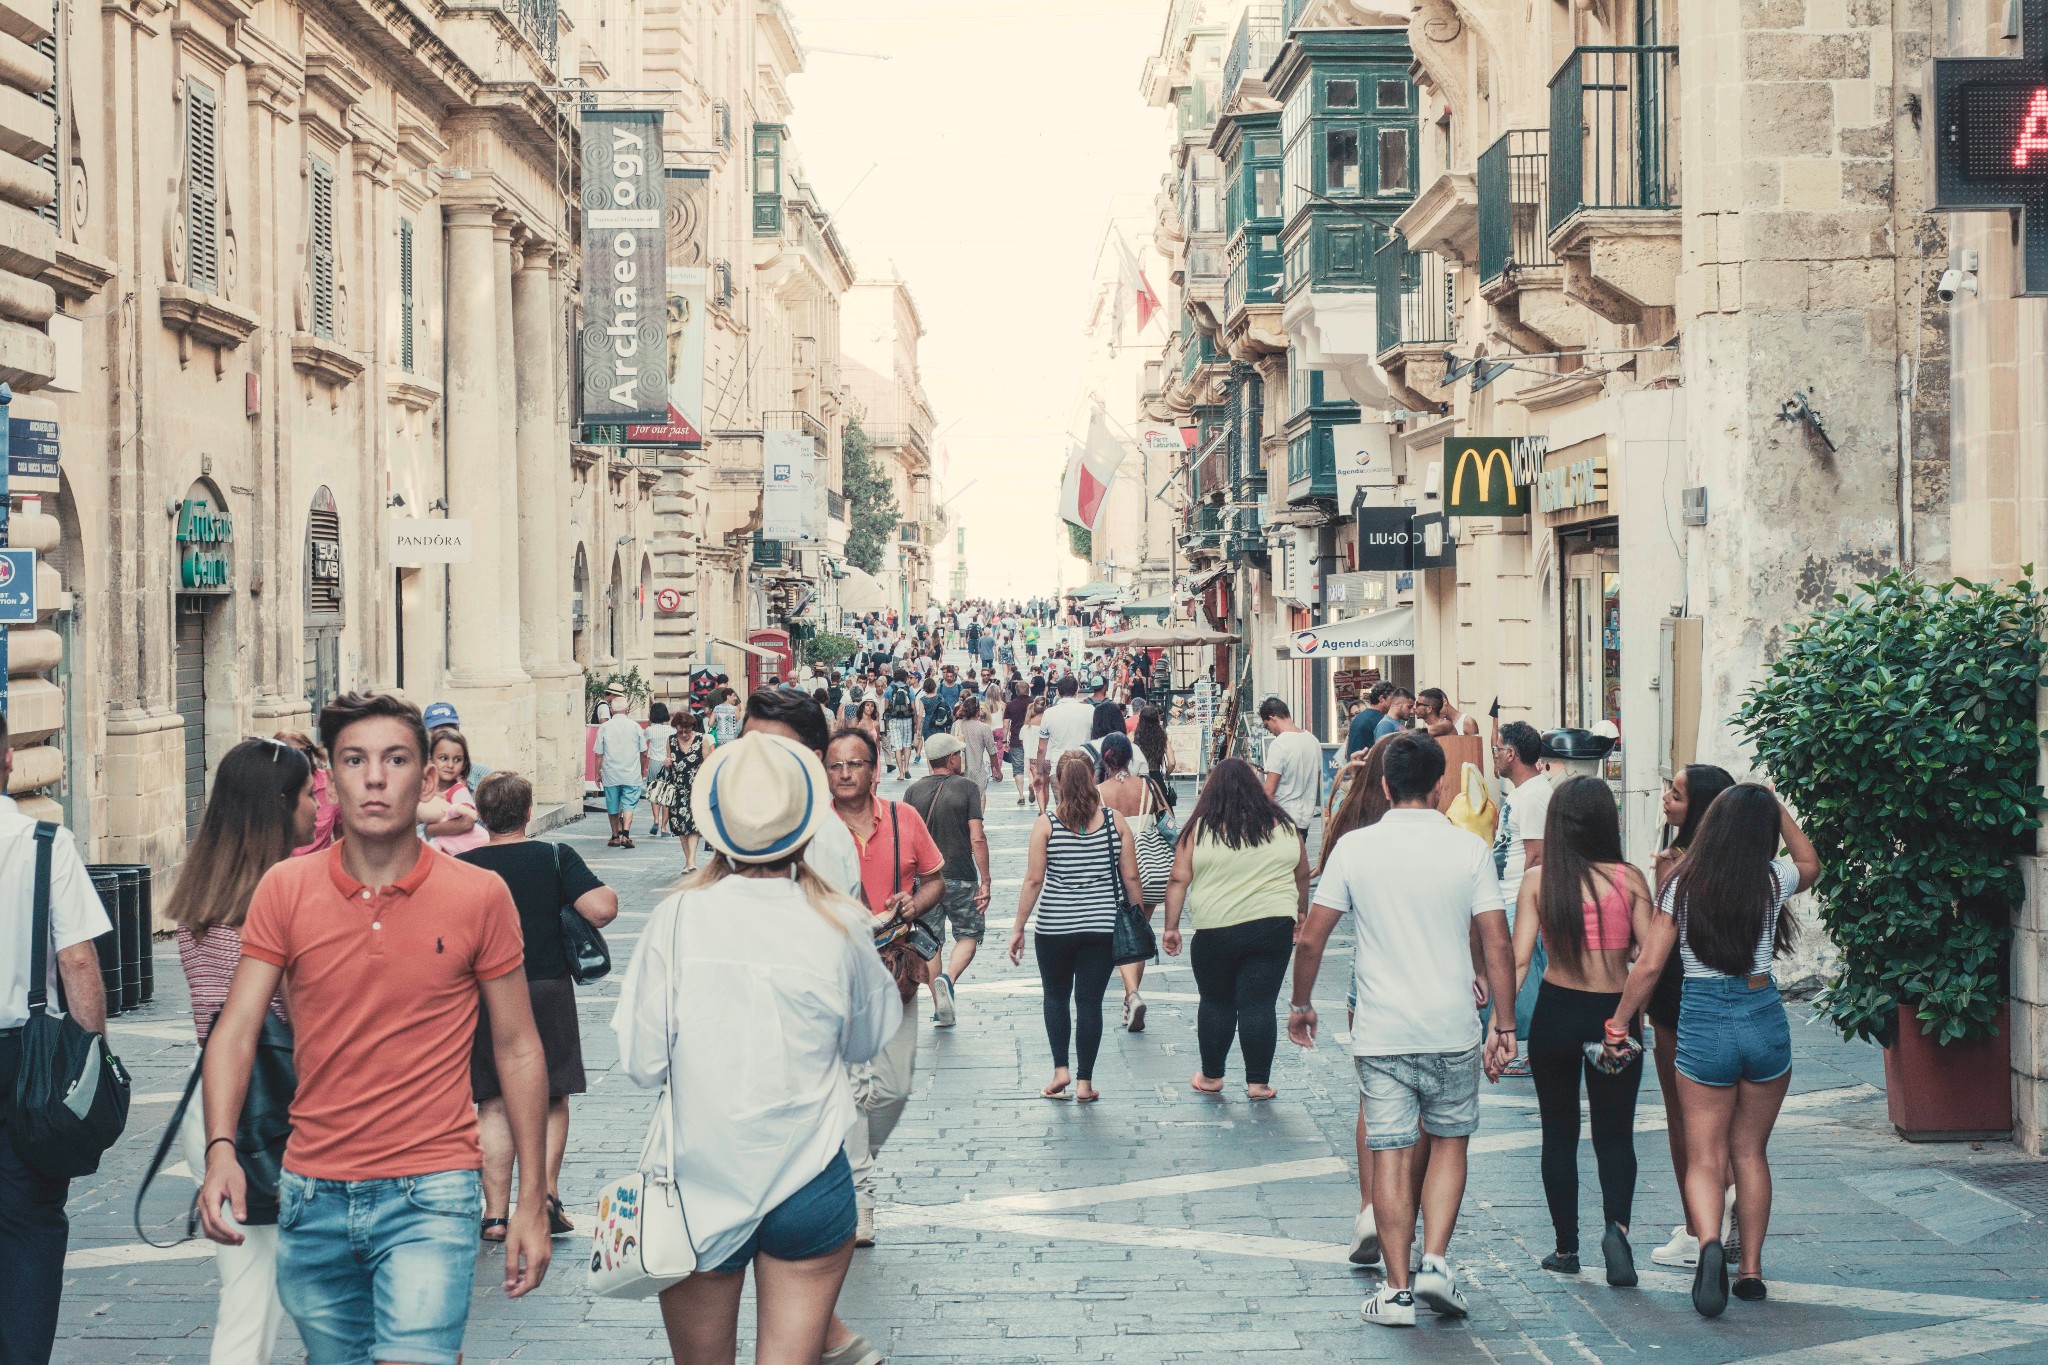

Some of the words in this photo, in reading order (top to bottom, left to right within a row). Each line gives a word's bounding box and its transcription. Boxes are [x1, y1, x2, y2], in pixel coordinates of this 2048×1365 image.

[632, 425, 651, 437] for
[651, 426, 669, 434] our
[668, 426, 690, 438] past
[1337, 466, 1391, 475] Agendabookshop
[177, 499, 233, 543] Artisans
[318, 560, 339, 578] LAB
